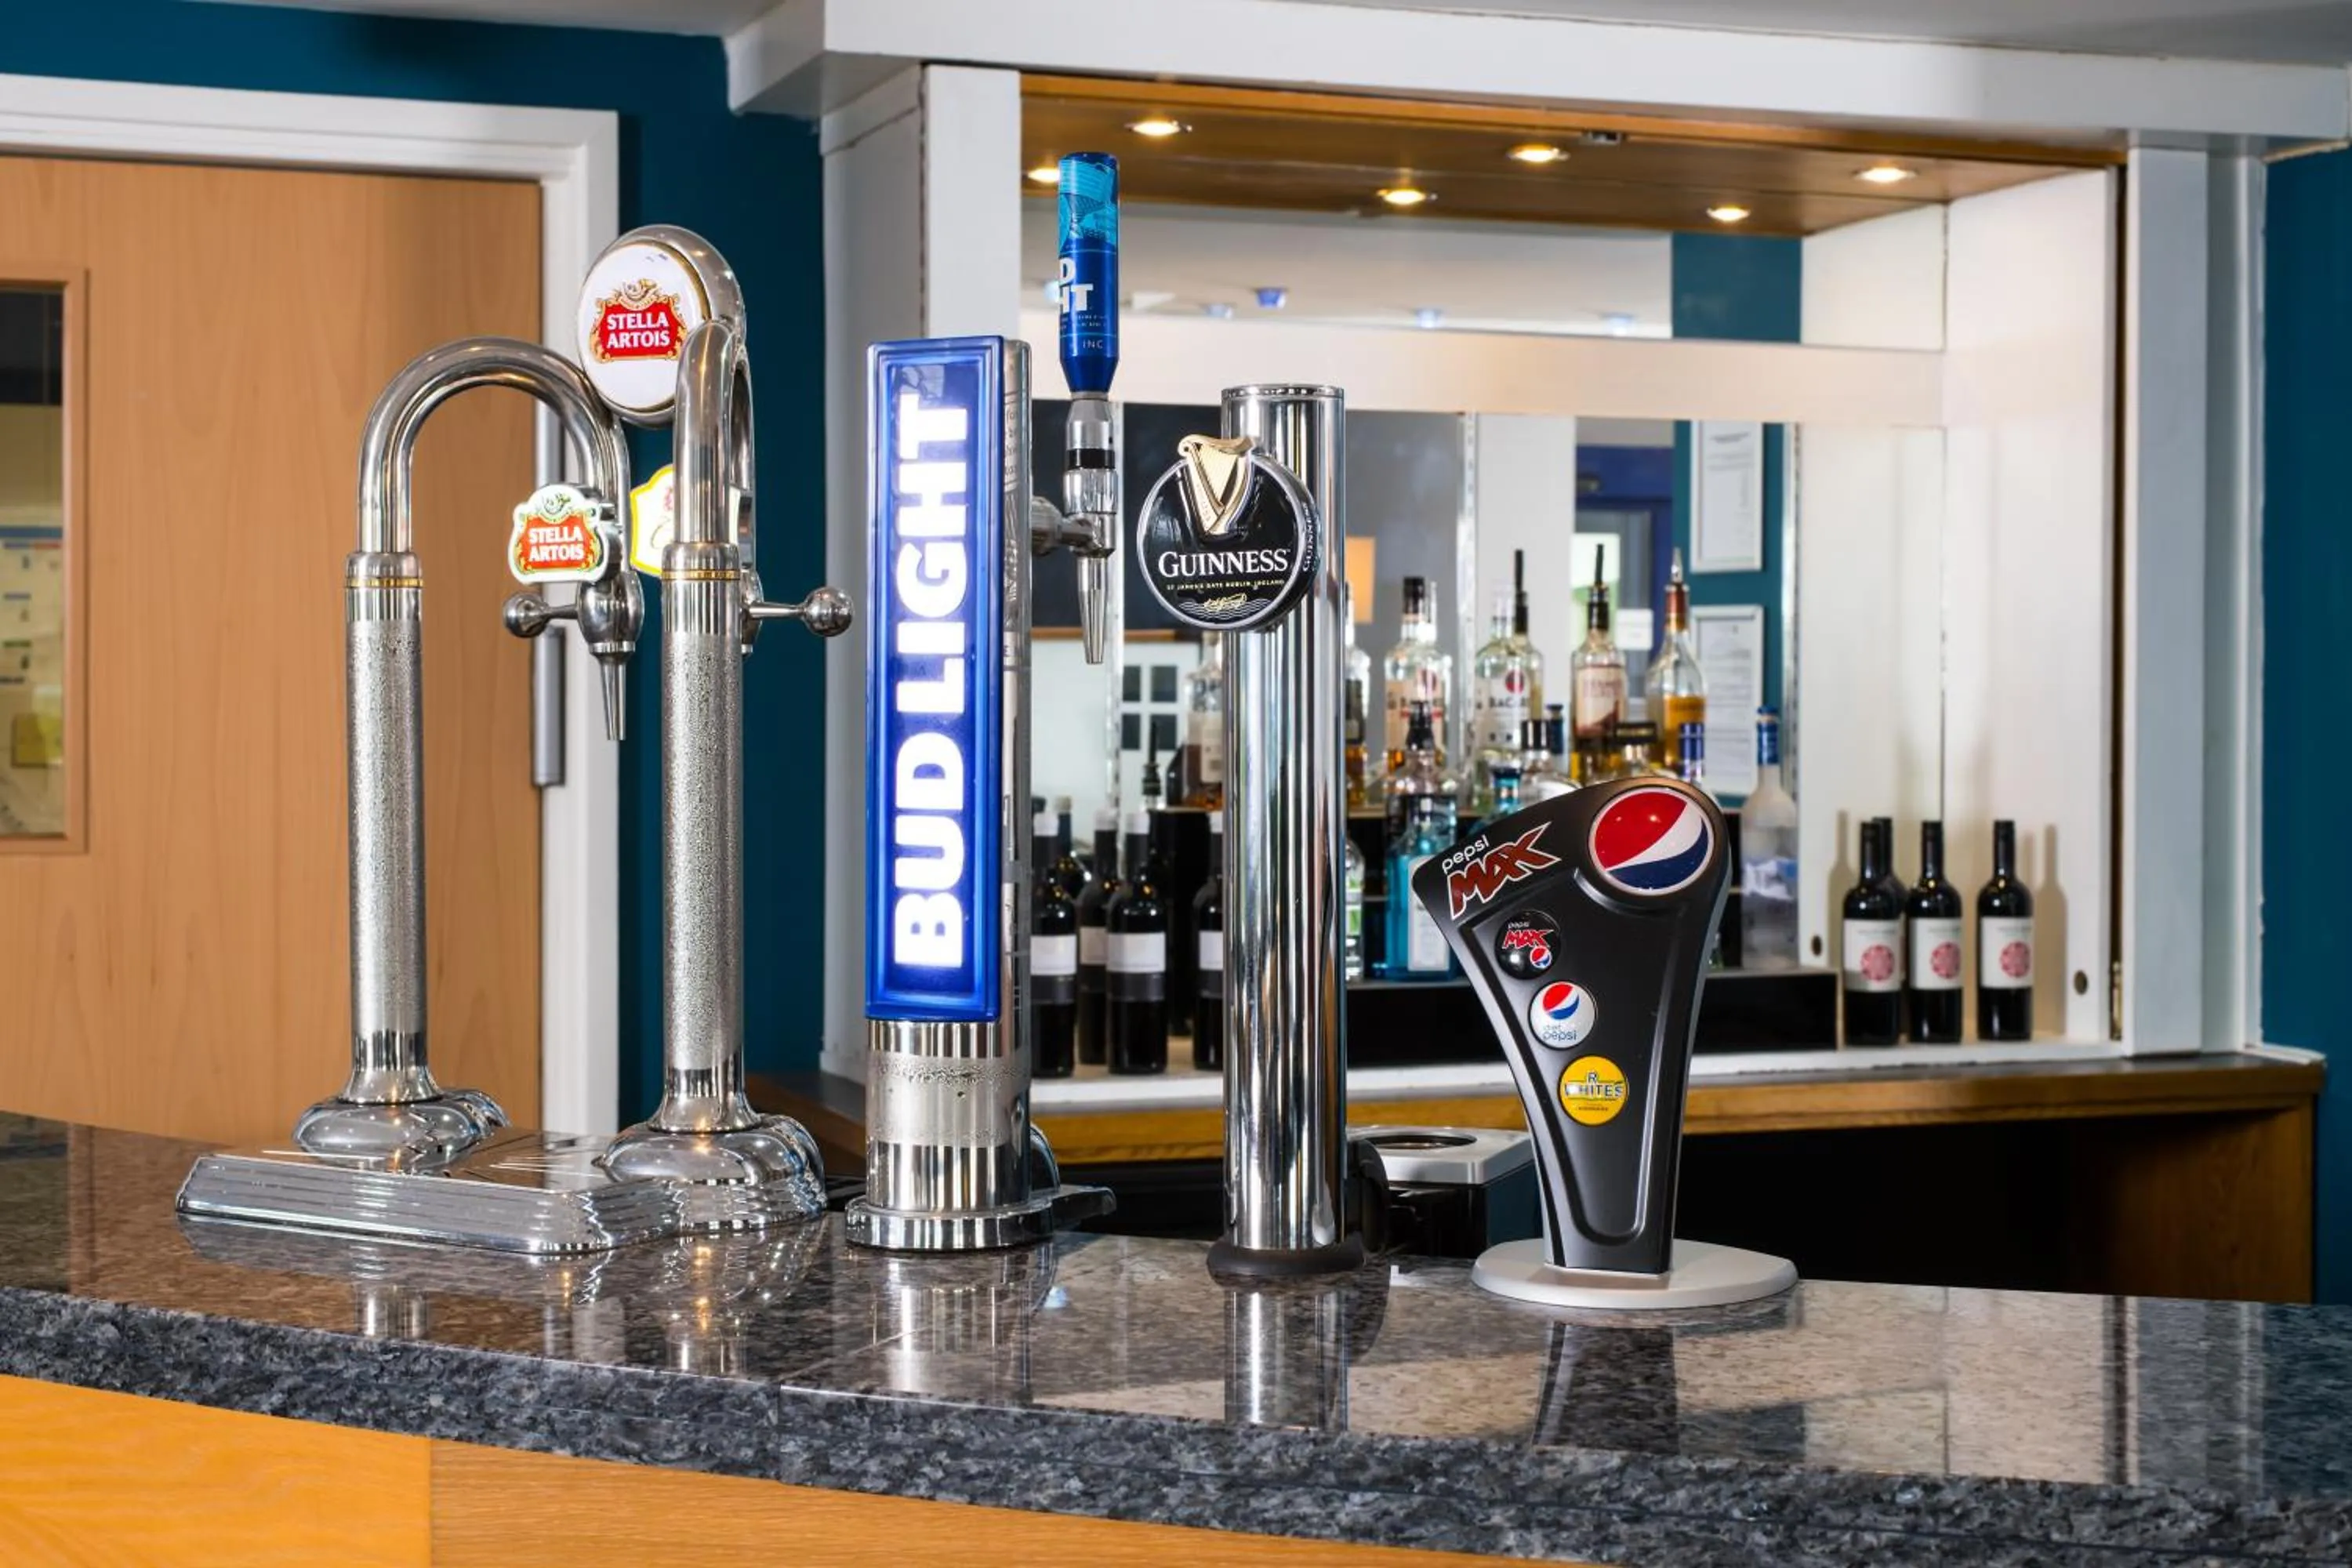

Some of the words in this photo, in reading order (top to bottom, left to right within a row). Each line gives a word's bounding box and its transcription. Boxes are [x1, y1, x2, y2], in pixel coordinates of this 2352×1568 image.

[606, 312, 670, 330] STELLA
[606, 330, 670, 348] ARTOIS
[528, 526, 584, 545] STELLA
[528, 543, 585, 562] ARTOIS
[895, 393, 968, 713] LIGHT
[1158, 549, 1288, 578] GUINNESS
[895, 731, 964, 969] BUD
[1442, 834, 1490, 875] pepsi
[1447, 821, 1562, 920] MAX
[1501, 928, 1555, 949] MAX
[1543, 1030, 1577, 1041] pepsi
